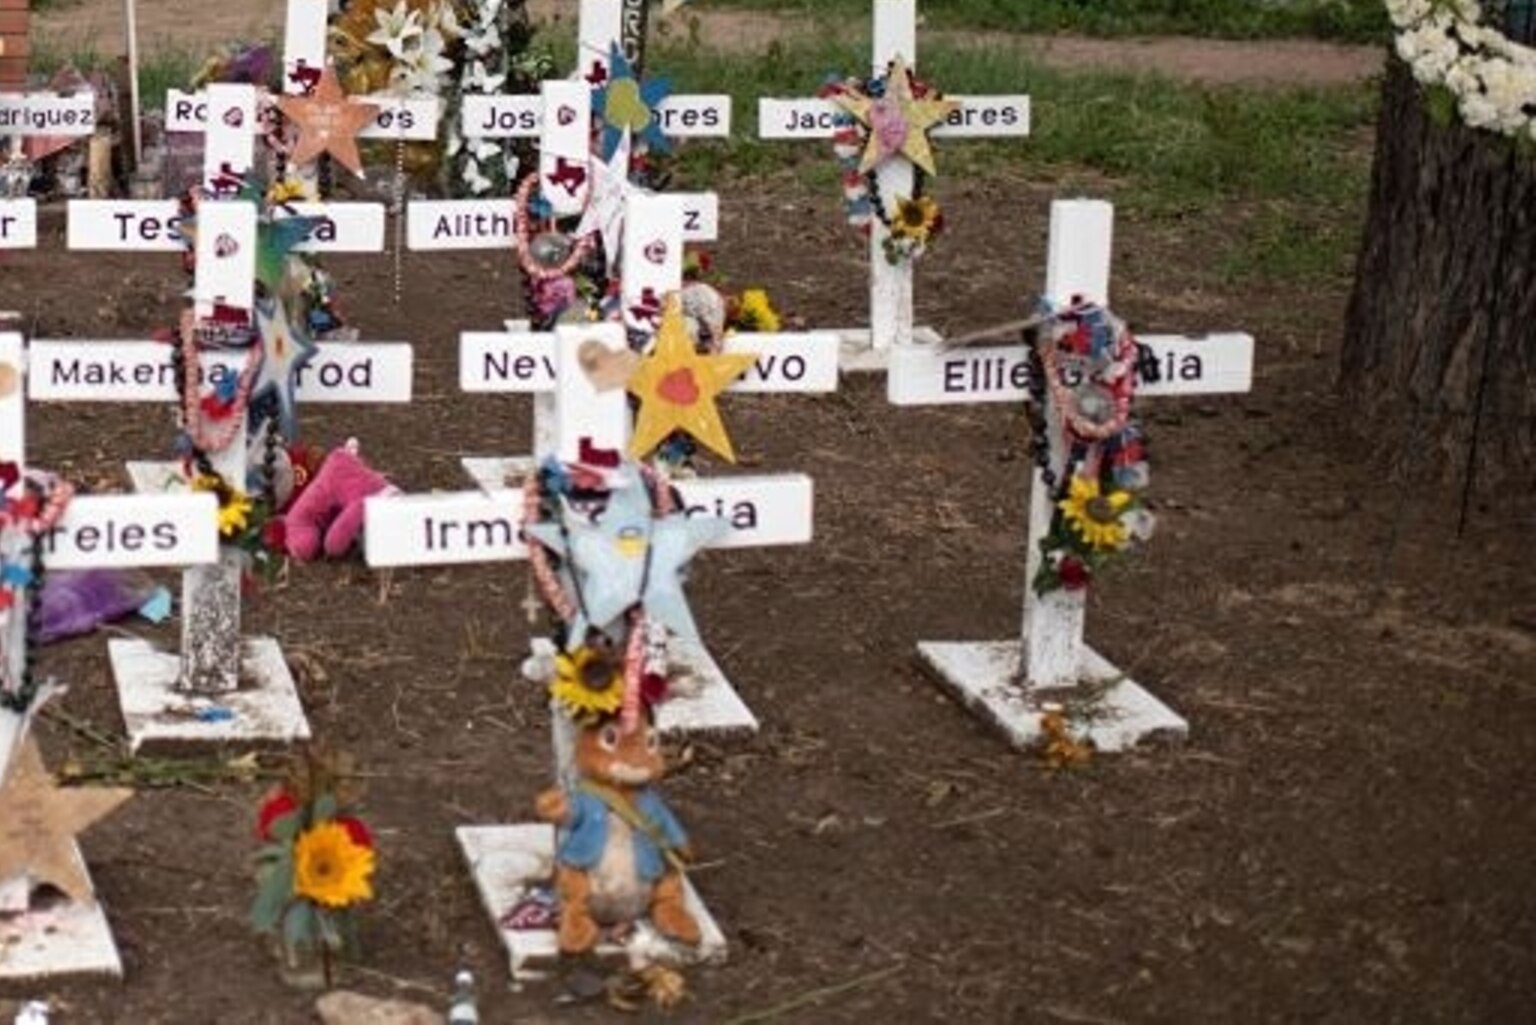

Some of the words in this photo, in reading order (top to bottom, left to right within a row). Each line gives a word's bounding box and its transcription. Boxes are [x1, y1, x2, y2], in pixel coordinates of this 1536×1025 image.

[482, 106, 537, 130] Jos
[785, 108, 833, 131] Jac
[946, 105, 1019, 126] ares
[113, 212, 185, 241] Tes
[432, 212, 513, 238] Alith
[296, 358, 373, 388] rod
[482, 350, 556, 380] Nev
[943, 359, 1034, 393] Ellie
